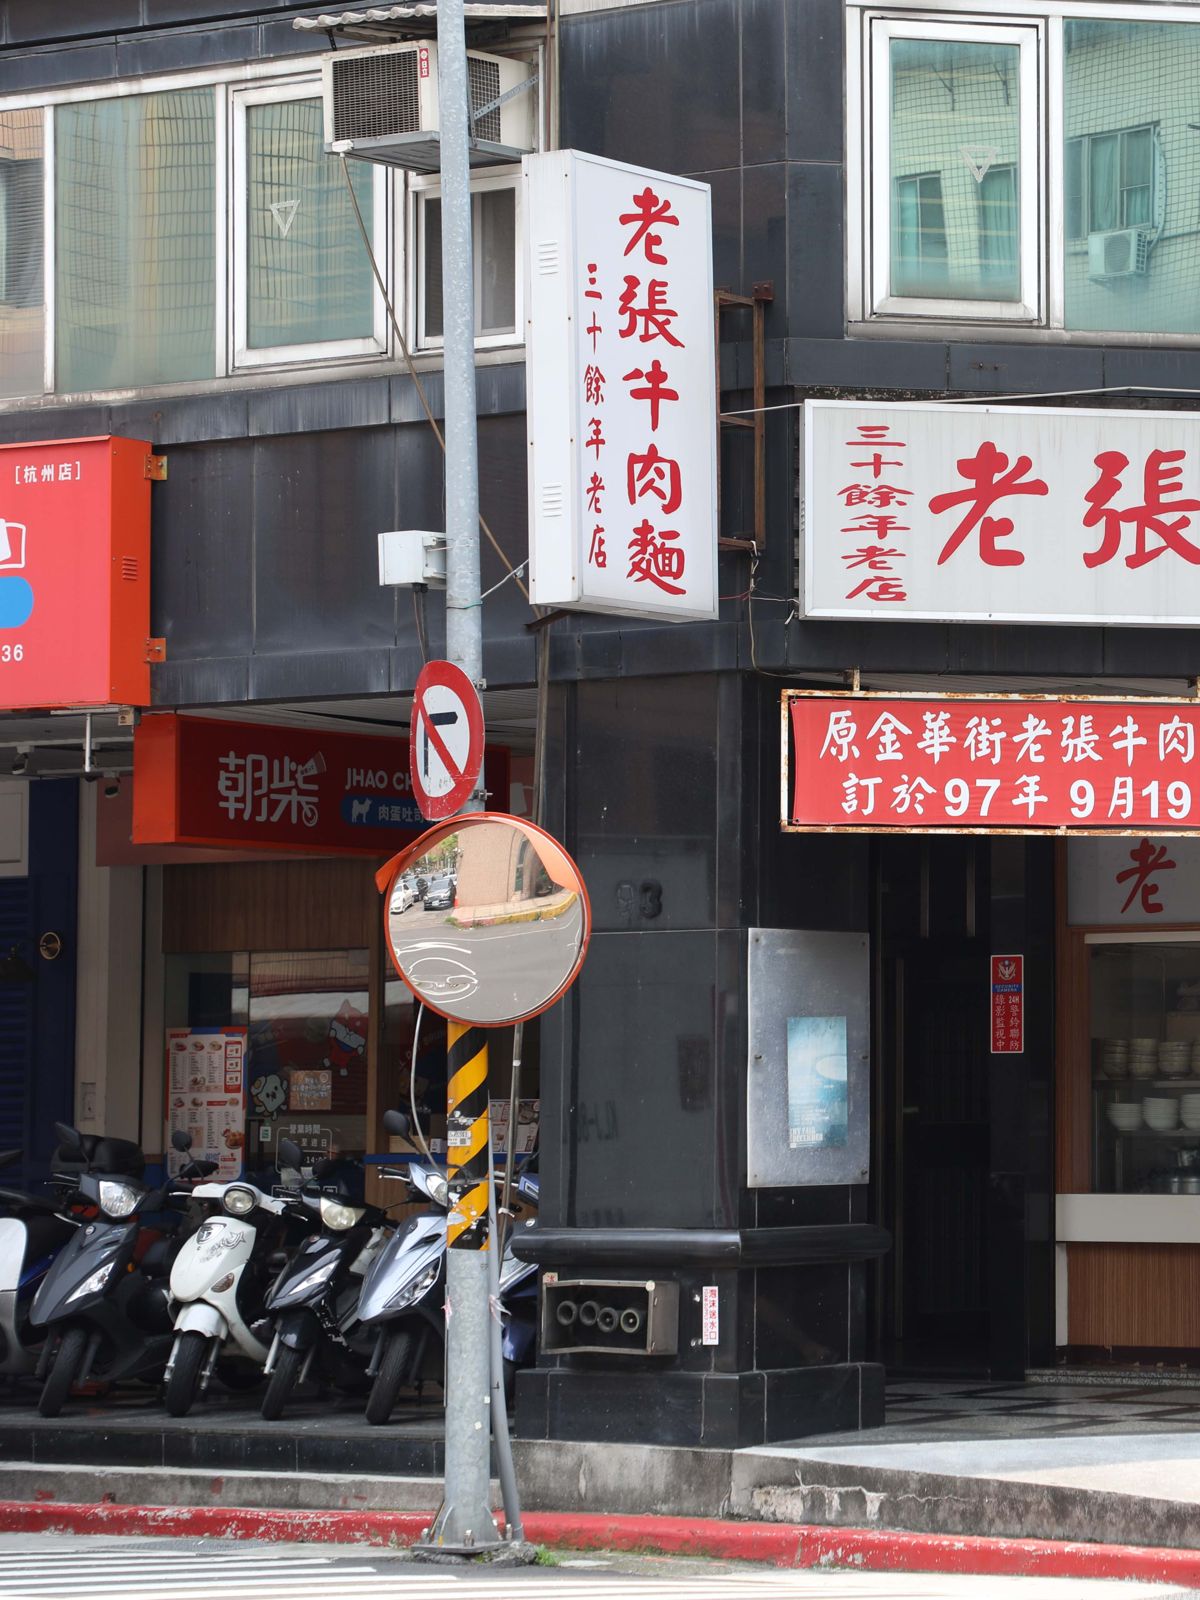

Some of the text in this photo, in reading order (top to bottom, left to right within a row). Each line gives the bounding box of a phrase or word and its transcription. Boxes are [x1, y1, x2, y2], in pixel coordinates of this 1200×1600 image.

[583, 263, 607, 569] 三十餘年老店
[618, 186, 686, 596] 老張牛肉麵
[837, 425, 915, 602] 三十餘年老店
[345, 767, 388, 790] JHAO
